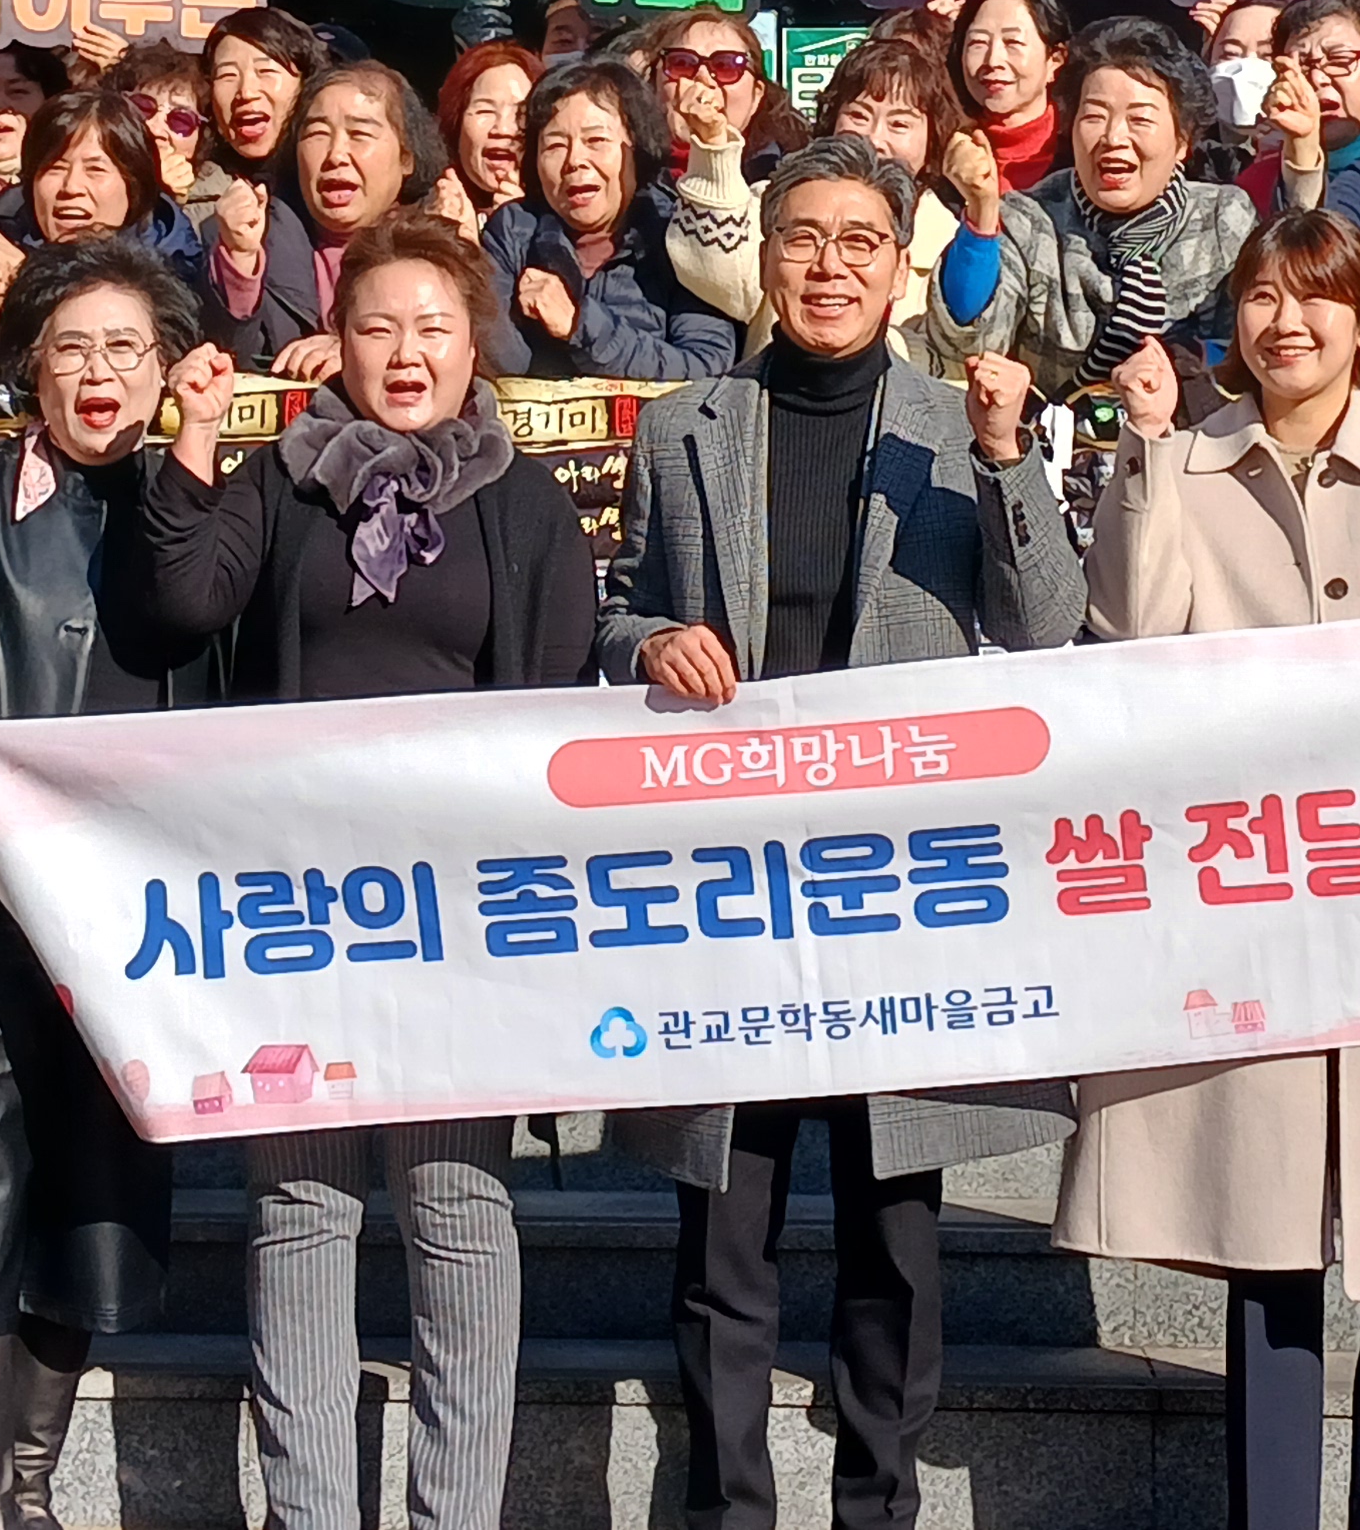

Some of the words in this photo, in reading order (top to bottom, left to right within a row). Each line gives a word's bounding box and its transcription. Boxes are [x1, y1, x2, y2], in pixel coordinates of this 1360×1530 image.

[501, 404, 598, 439] 경기미
[640, 718, 958, 790] MG희망나눔
[124, 860, 446, 981] 사랑의
[477, 822, 1011, 959] 좀도리운동
[1044, 808, 1153, 917] 쌀
[656, 984, 1060, 1051] 관교문학동새마을금고
